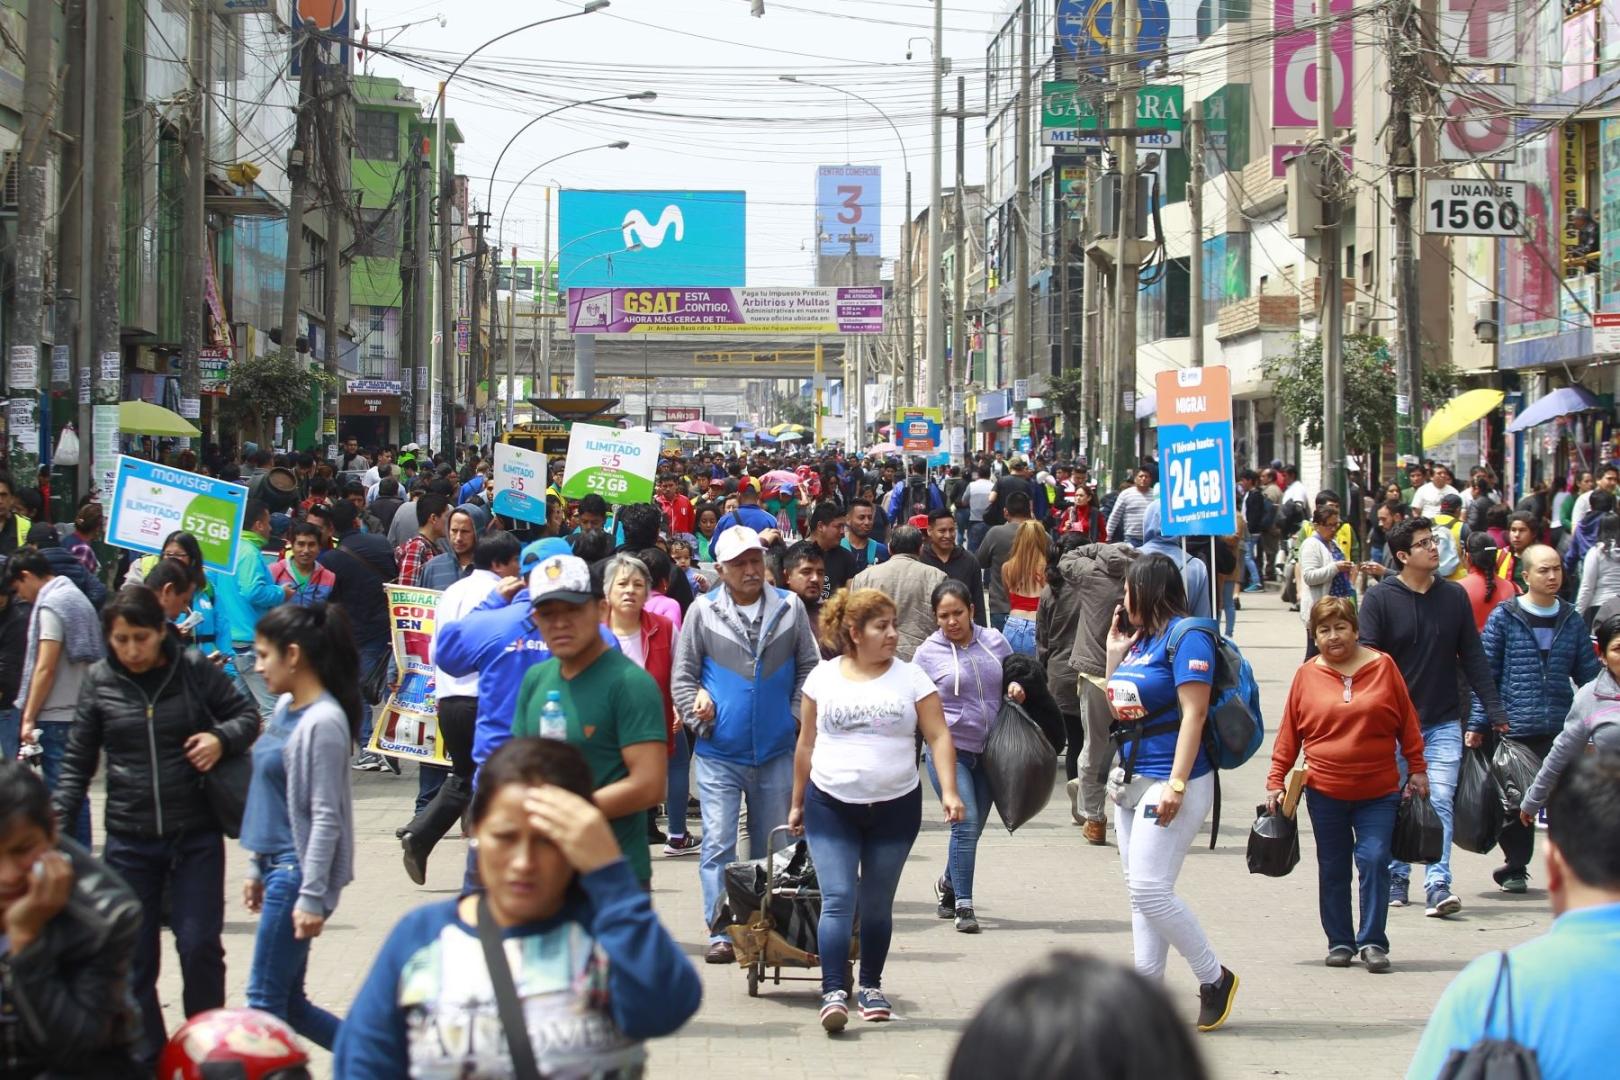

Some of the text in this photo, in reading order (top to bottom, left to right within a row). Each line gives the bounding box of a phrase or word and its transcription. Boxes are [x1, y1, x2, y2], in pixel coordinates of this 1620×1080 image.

[837, 185, 863, 225] 3
[1431, 199, 1519, 230] 1560
[623, 292, 681, 314] GSAT
[685, 292, 710, 301] ESTA
[742, 297, 830, 308] Arbitrios y Multas
[684, 303, 731, 313] CONTIGO,
[652, 314, 672, 323] MÁS
[586, 440, 641, 456] ILIMITADO
[601, 454, 621, 467] S/5
[503, 463, 534, 479] ILIMITADO
[151, 468, 215, 493] movistar
[586, 475, 628, 492] 52 GB
[1169, 458, 1221, 510] 24 GB
[126, 500, 181, 521] ILIMITADO
[185, 516, 206, 533] 52
[207, 521, 231, 540] GB
[396, 619, 422, 631] EN
[382, 742, 429, 756] CORTINAS
